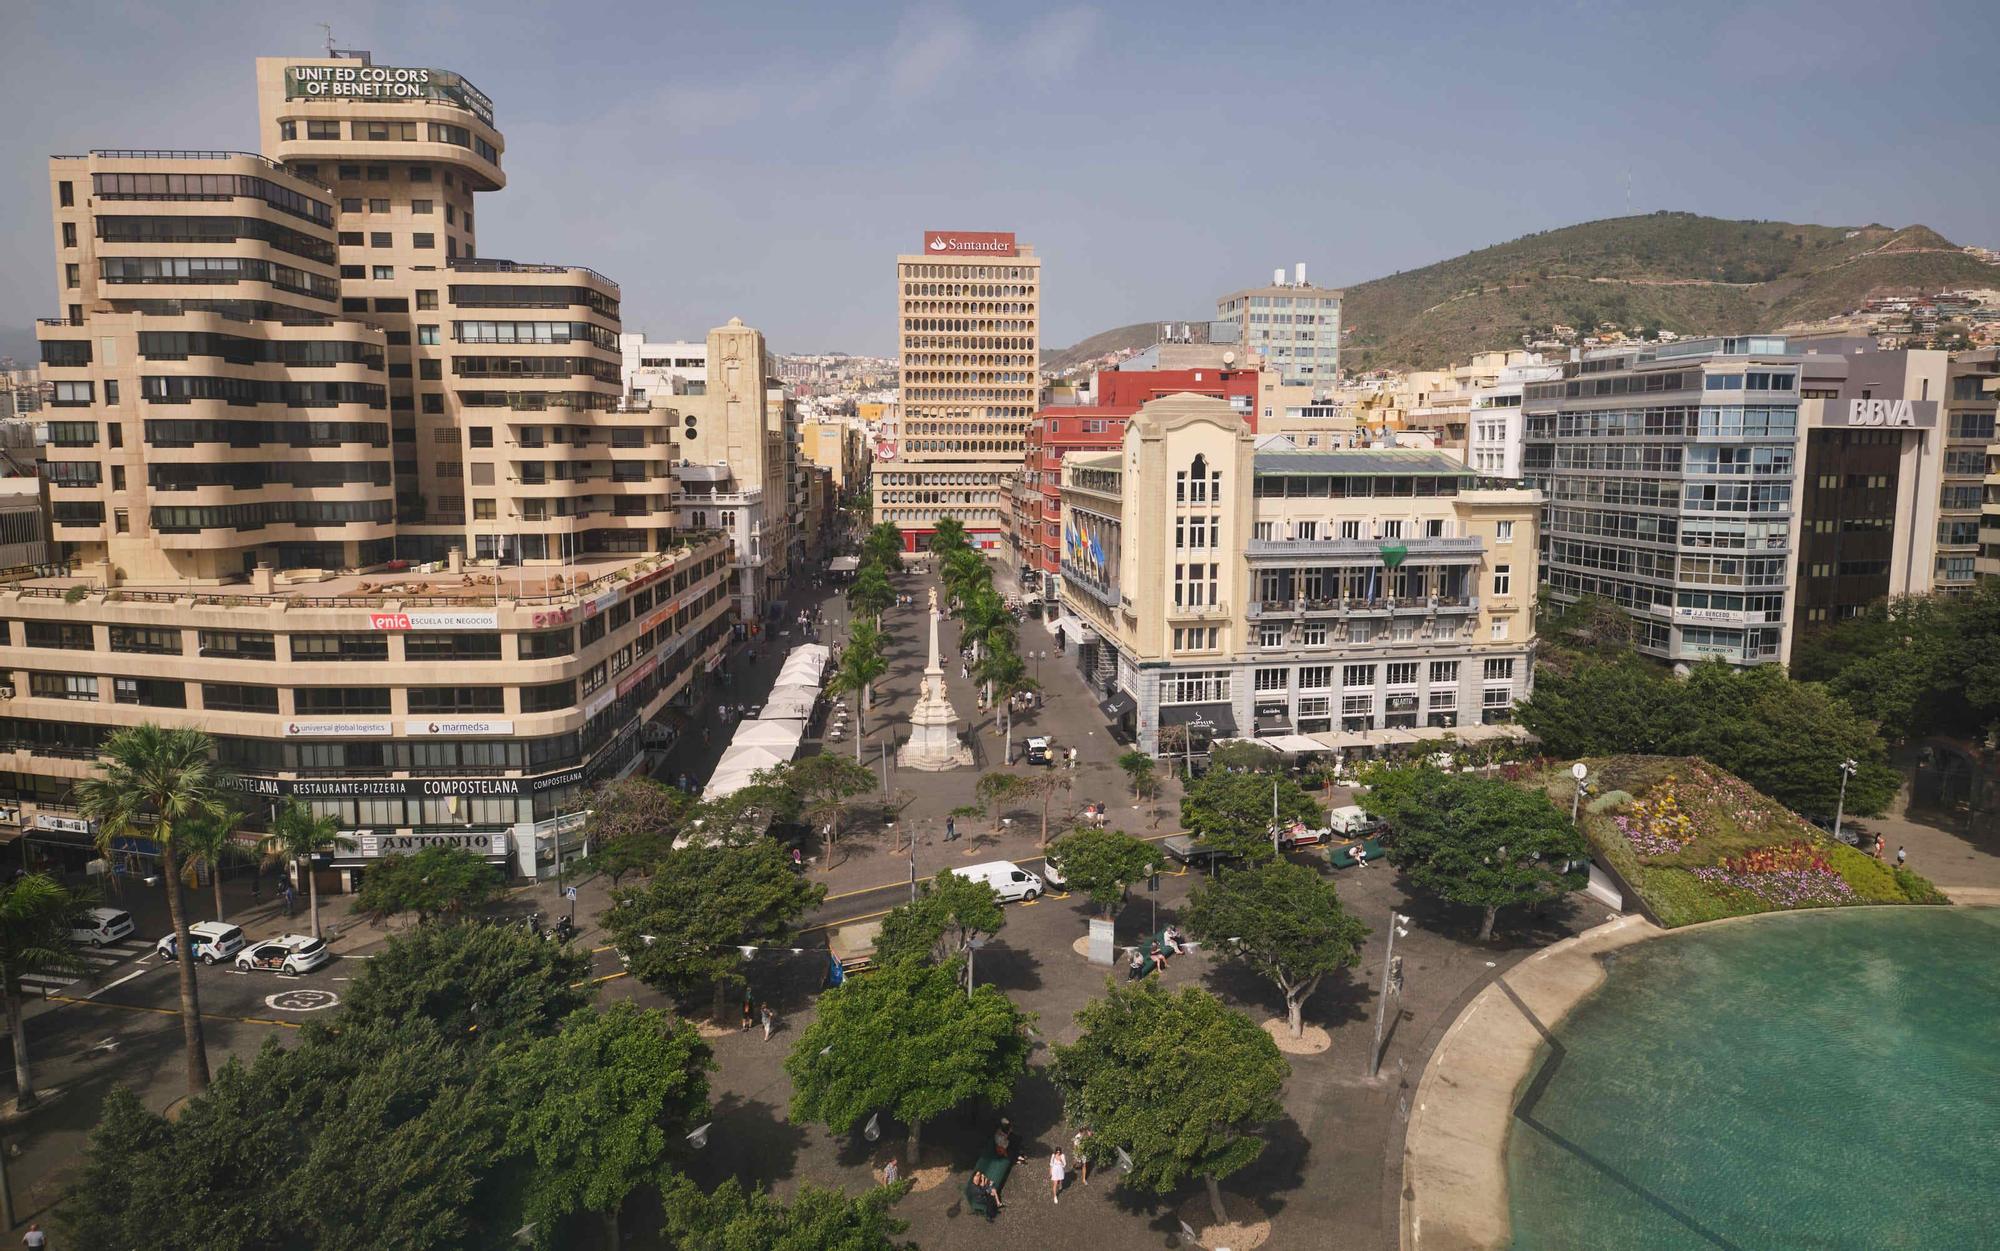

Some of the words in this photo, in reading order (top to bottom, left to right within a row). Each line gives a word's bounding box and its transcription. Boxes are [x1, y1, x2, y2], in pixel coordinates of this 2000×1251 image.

[295, 68, 356, 81] UNITED
[360, 68, 429, 83] COLORS
[307, 81, 329, 95] OF
[333, 82, 425, 97] BENETTON.
[949, 238, 1010, 251] Santander
[1848, 398, 1916, 427] BBVA
[376, 615, 408, 629] enic
[411, 617, 442, 625] ESCUELA
[456, 617, 493, 625] NEGOCIOS
[301, 723, 333, 732] universal
[442, 722, 490, 732] marmedsa
[293, 783, 406, 795] RESTAURANTE-PIZZERIA
[424, 780, 519, 795] COMPOSTELANA
[533, 772, 583, 790] COMPOSTELANA
[382, 834, 489, 850] ANTONIO
